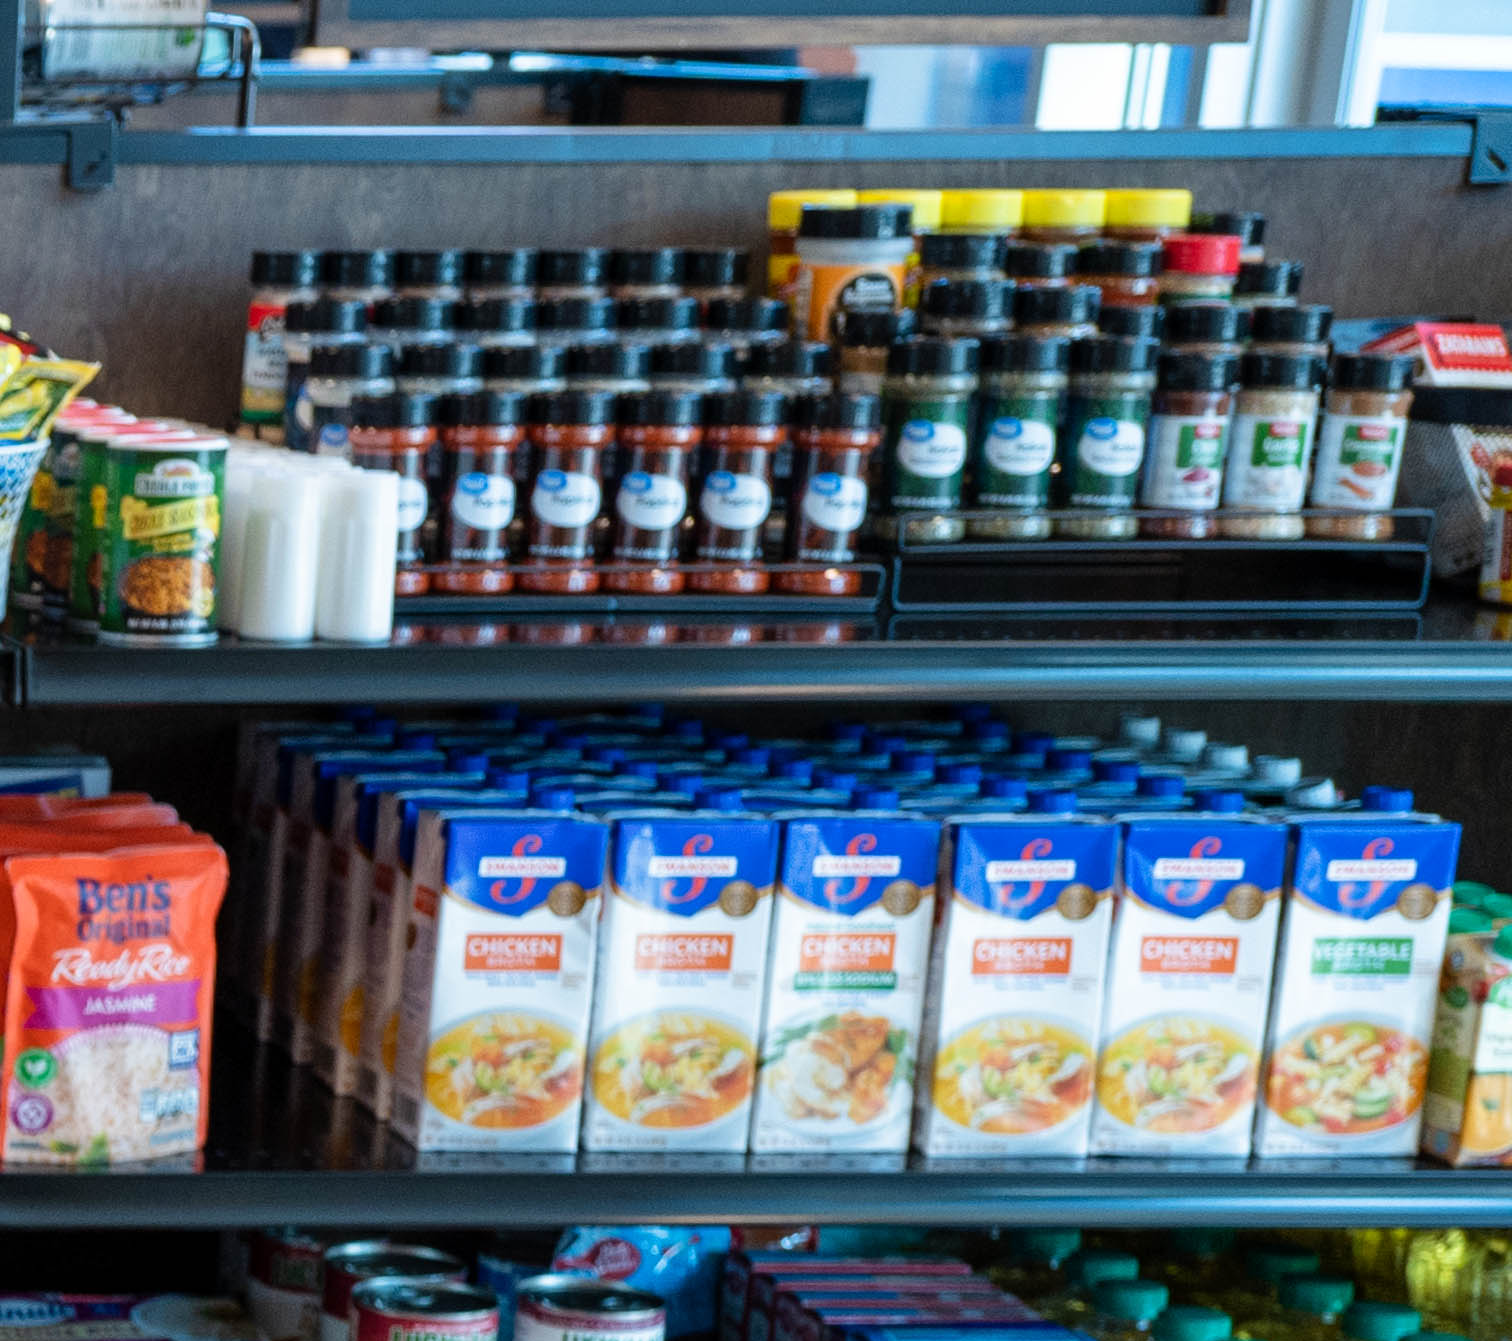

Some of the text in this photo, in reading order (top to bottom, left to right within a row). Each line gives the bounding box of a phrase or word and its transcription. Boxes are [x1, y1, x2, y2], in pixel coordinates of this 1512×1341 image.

[76, 876, 172, 914] Ben's
[76, 914, 171, 945] Original
[468, 937, 556, 957] CHICKEN
[803, 937, 890, 958] CHICKEN
[1142, 938, 1234, 960] CHICKEN
[1314, 940, 1412, 961] VEGETABLE
[84, 994, 157, 1016] JASMINE
